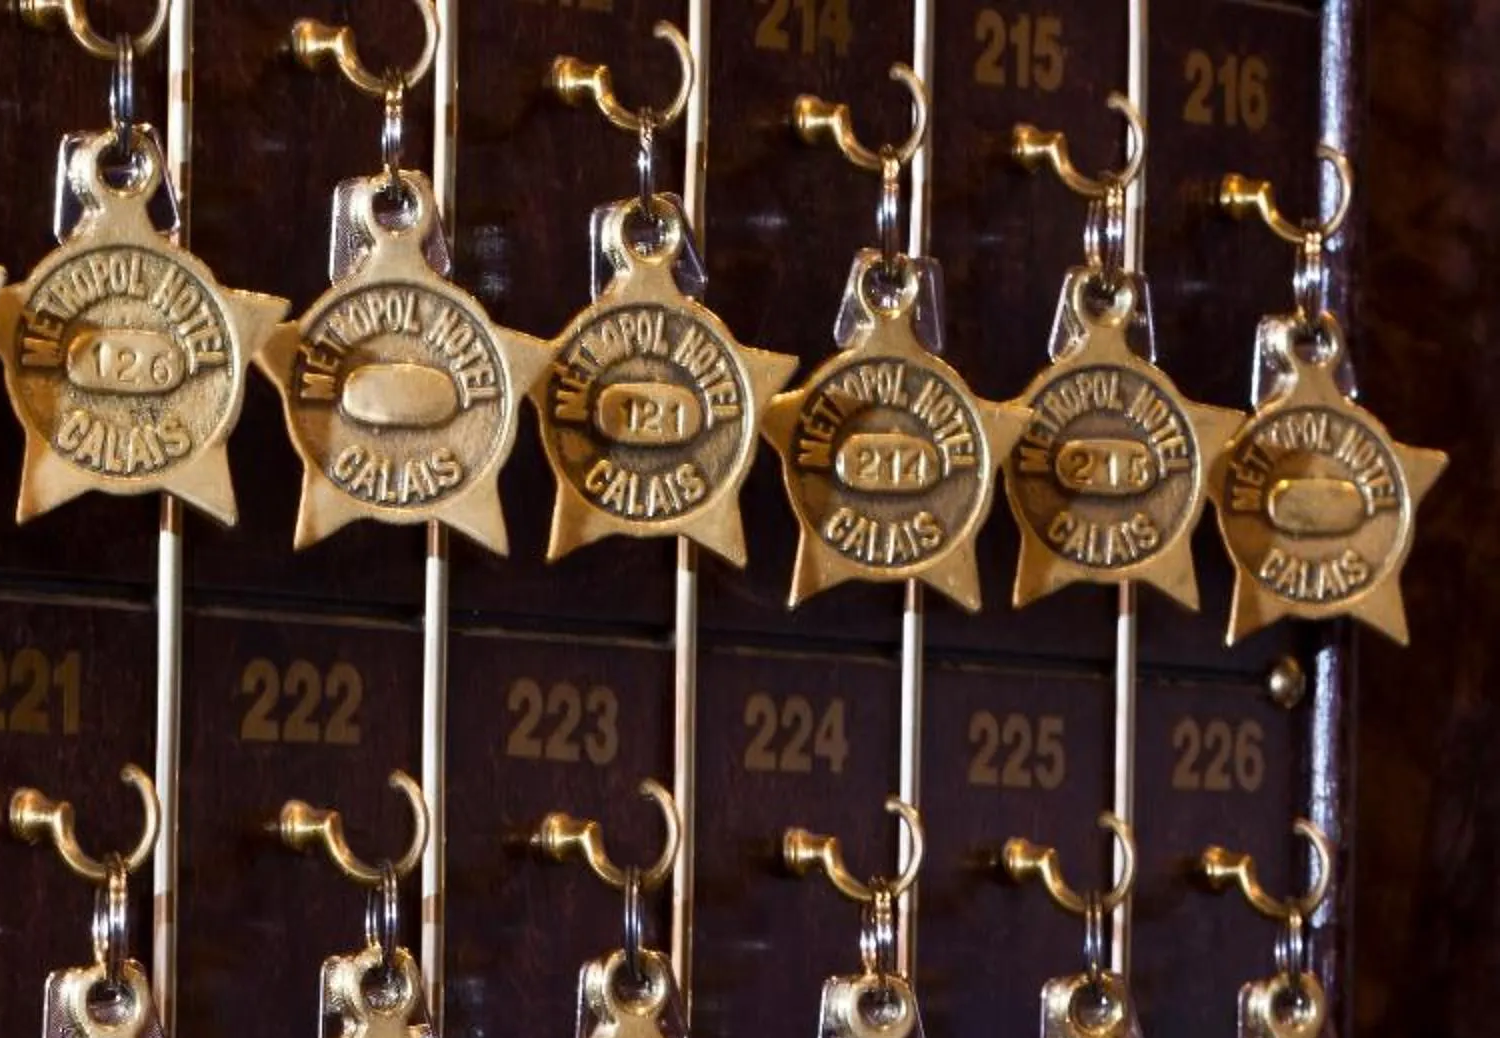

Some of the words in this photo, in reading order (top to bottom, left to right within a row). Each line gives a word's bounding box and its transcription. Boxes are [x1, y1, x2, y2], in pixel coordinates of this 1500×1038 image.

[755, 0, 853, 56] 214
[975, 10, 1063, 90] 215
[1183, 49, 1268, 132] 216
[151, 266, 225, 374] HOTEL
[426, 303, 498, 408] HOTEL
[93, 342, 172, 385] 126
[674, 325, 740, 426] HOTEL
[56, 410, 189, 472] CALAIS
[624, 399, 684, 439] 121
[912, 377, 976, 475] HOTEL
[1128, 383, 1189, 478] HOTEL
[332, 441, 462, 501] CALAIS
[584, 457, 705, 515] CALAIS
[1336, 424, 1397, 516] HOTEL
[825, 505, 942, 562] CALAIS
[1047, 509, 1159, 563] CALAIS
[1259, 546, 1368, 599] CALAIS
[241, 658, 362, 744] 222
[507, 677, 618, 765] 223
[744, 693, 848, 773] 224
[968, 709, 1064, 789] 225
[1172, 715, 1264, 791] 226
